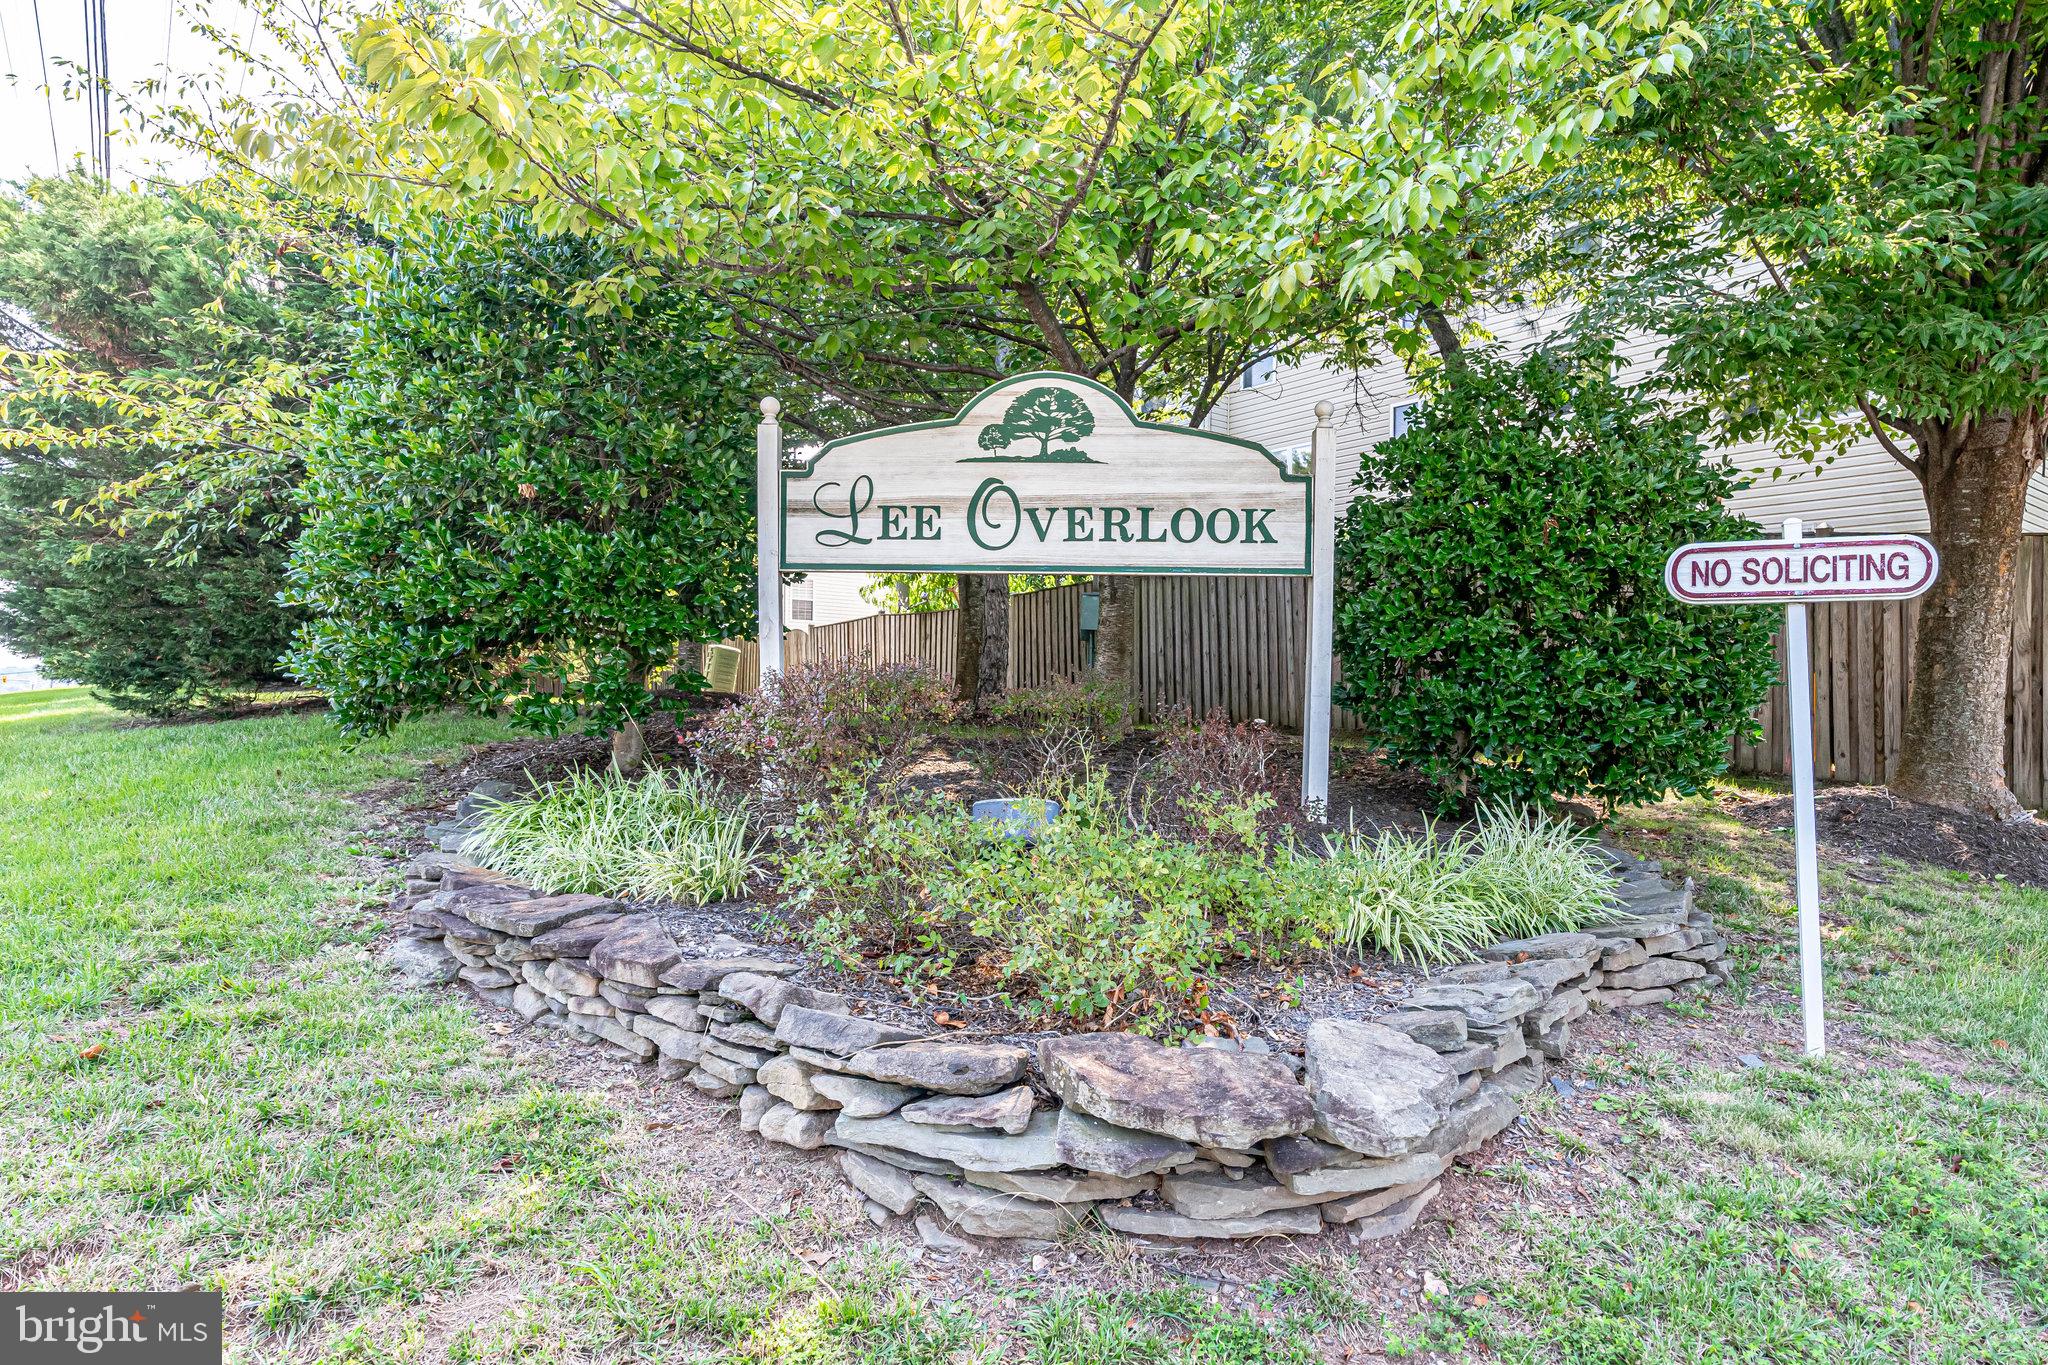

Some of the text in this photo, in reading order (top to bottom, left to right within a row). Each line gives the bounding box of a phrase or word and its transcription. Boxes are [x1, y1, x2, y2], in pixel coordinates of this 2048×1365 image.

[813, 474, 1278, 551] LEE OVERLOOK
[1691, 551, 1910, 587] NO SOLICITING
